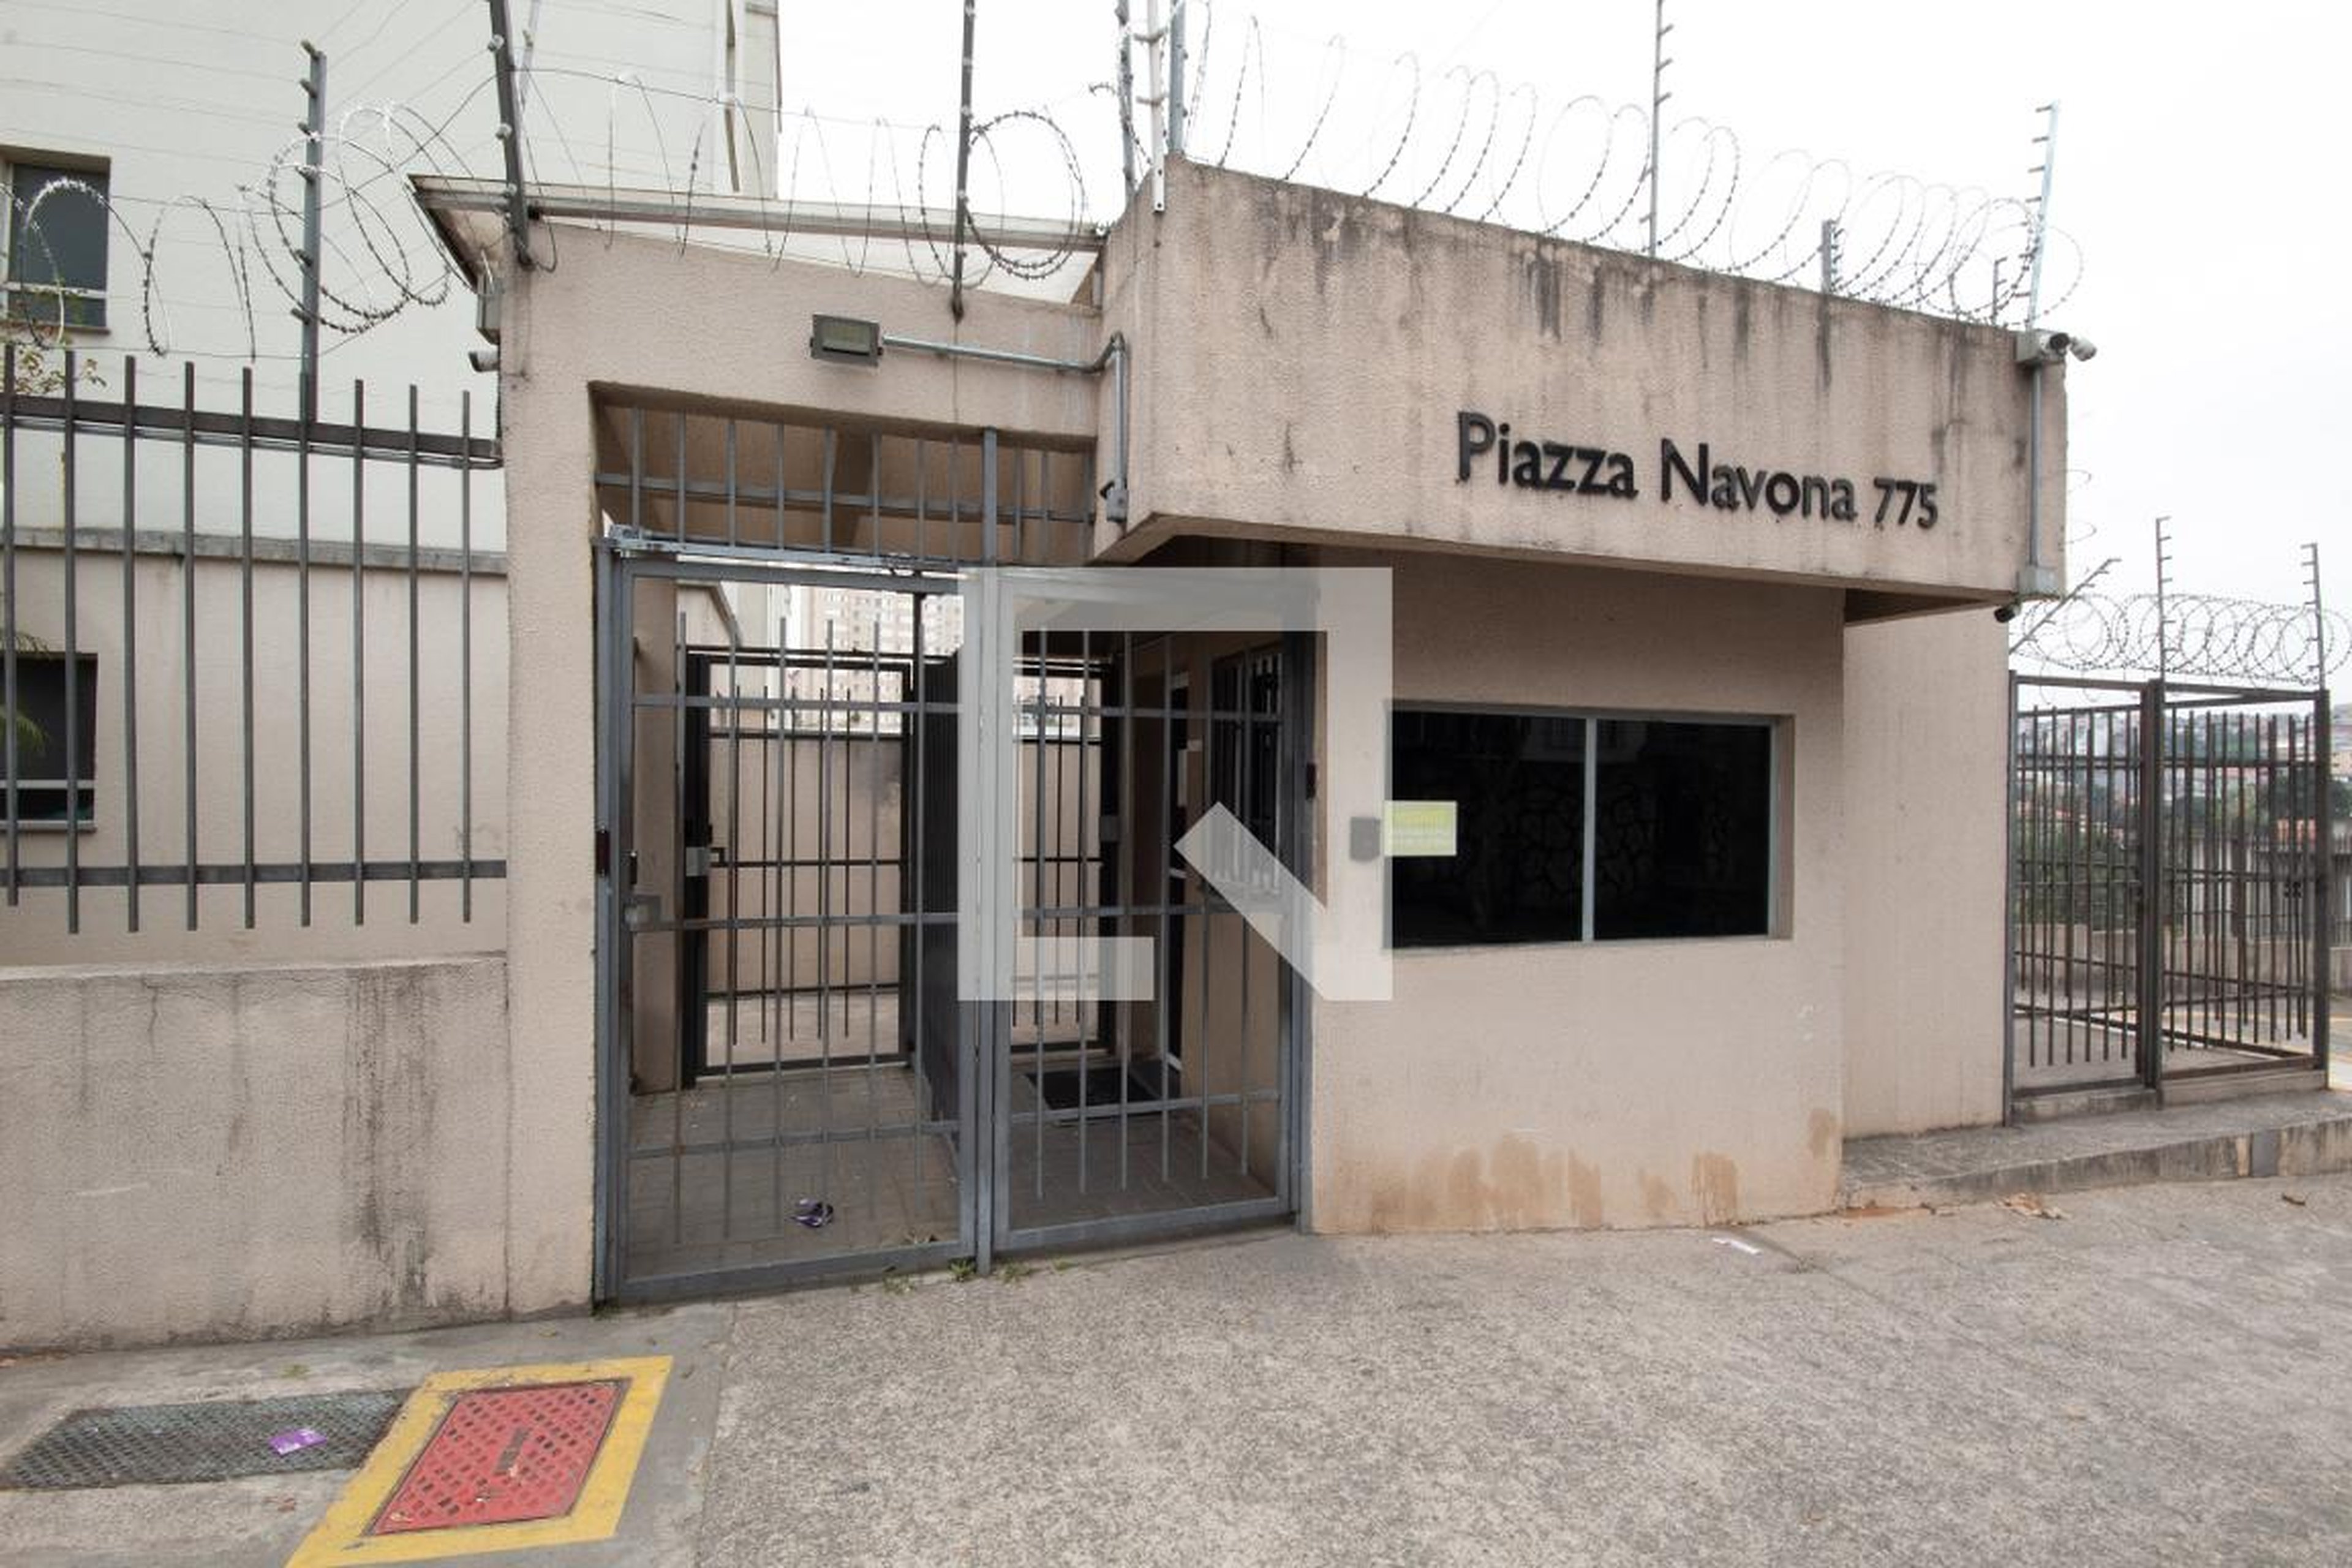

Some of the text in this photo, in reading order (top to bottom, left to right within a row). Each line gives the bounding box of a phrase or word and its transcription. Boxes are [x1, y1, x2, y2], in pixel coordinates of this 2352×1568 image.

[1458, 412, 1938, 529] Piazza Navona 775
